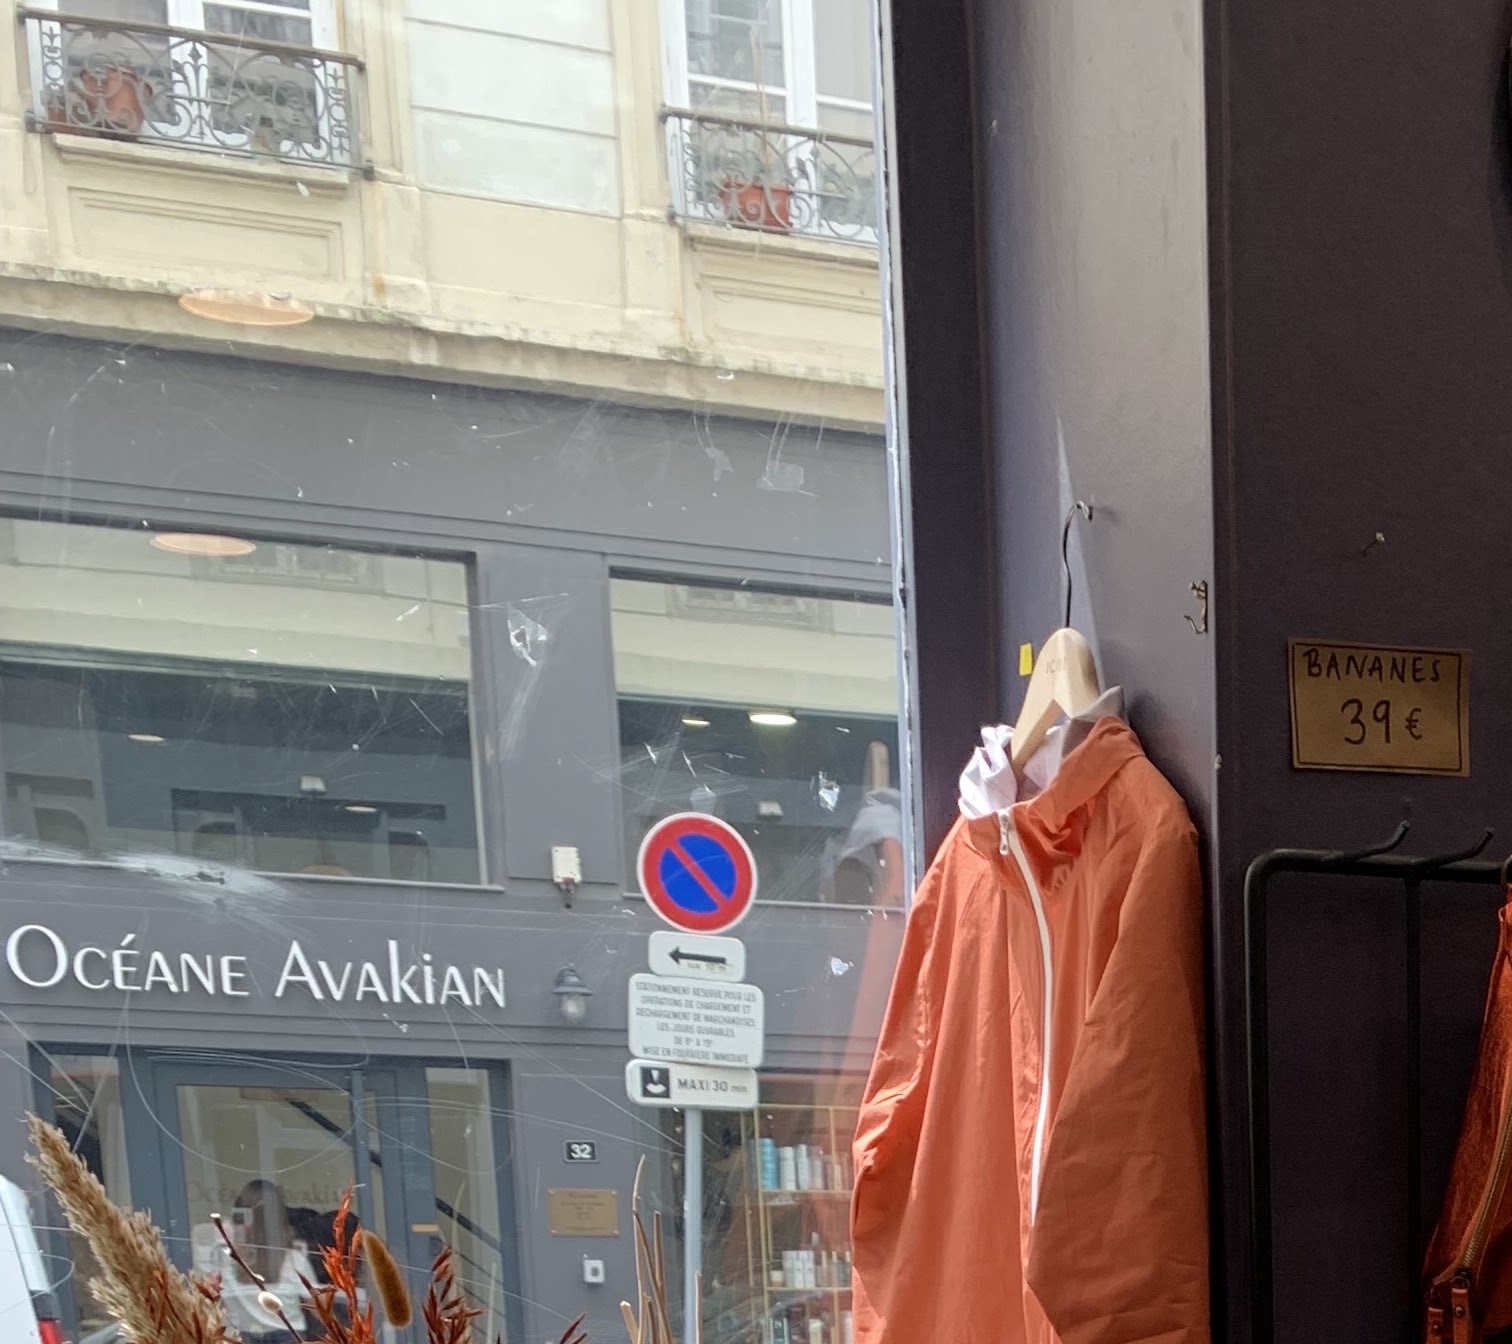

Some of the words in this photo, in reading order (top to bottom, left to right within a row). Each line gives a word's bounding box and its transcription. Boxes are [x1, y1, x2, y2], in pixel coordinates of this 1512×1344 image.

[1302, 647, 1441, 684] BANANES
[1340, 698, 1392, 745] 39
[677, 1077, 710, 1092] MAXI
[711, 1080, 728, 1092] 30
[570, 1143, 592, 1159] 32
